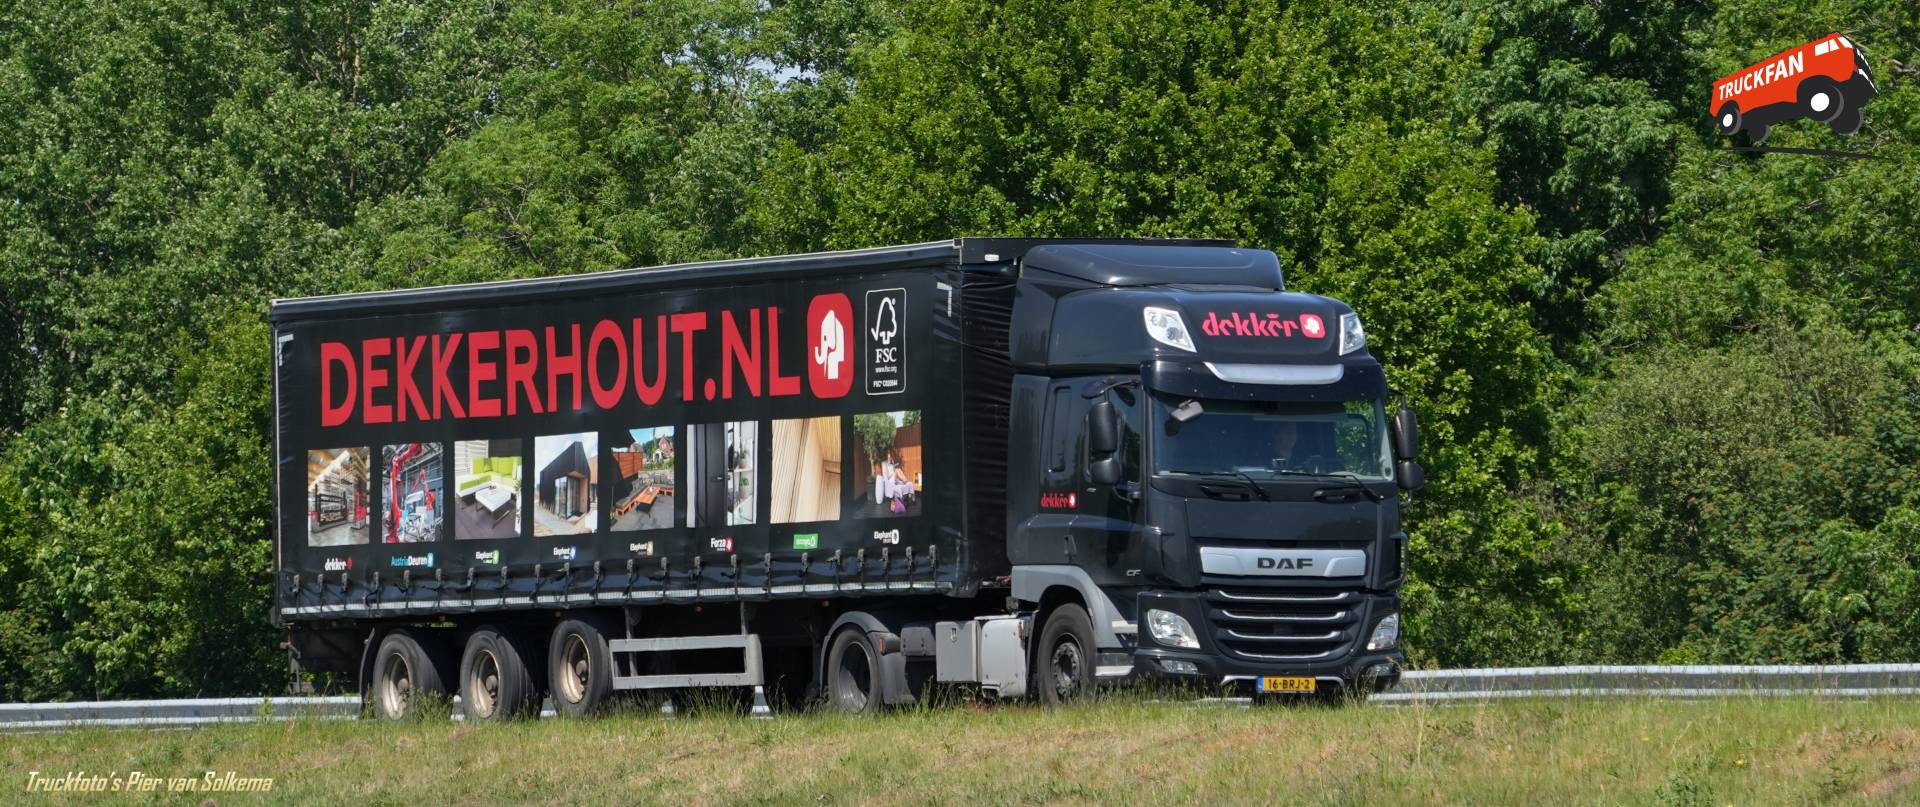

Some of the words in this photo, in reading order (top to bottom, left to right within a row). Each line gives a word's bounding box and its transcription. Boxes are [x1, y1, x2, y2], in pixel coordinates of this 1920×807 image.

[875, 347, 897, 364] FSC
[320, 306, 801, 427] DEKKERHOUT.NL
[1257, 557, 1314, 570] DAF
